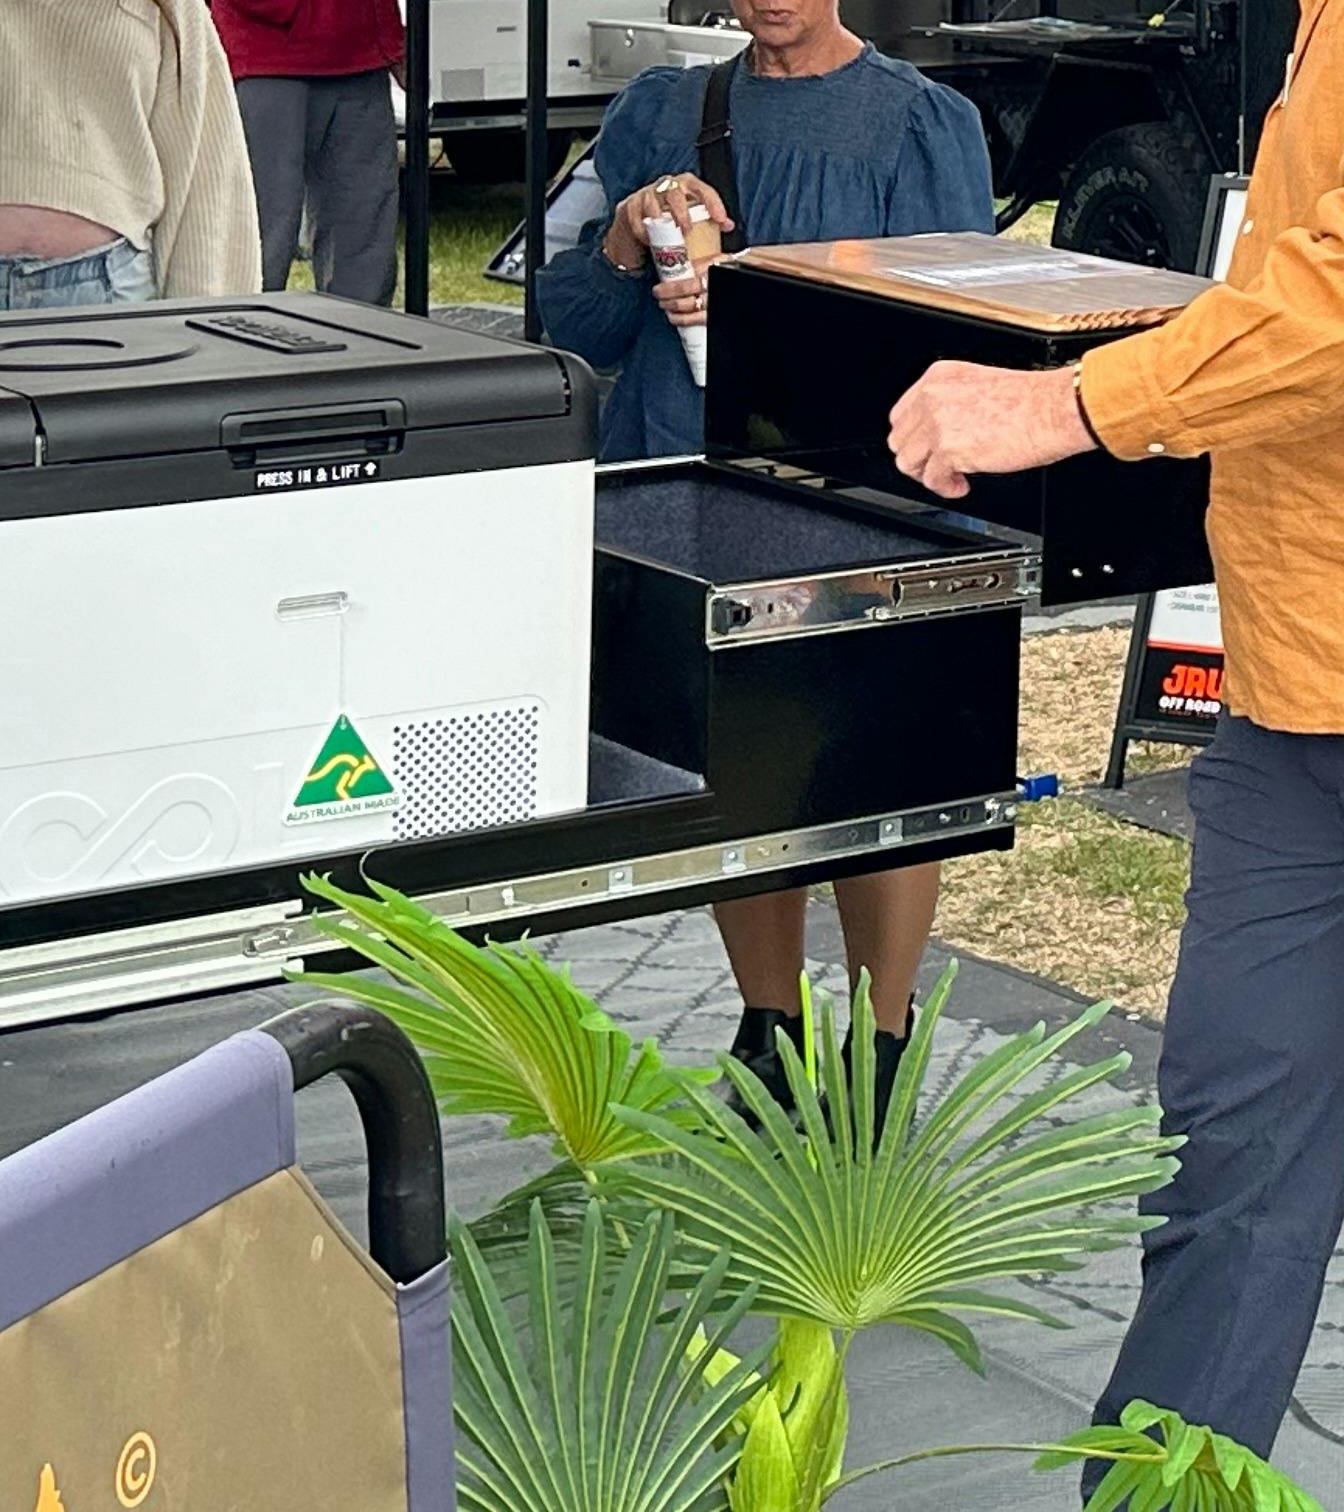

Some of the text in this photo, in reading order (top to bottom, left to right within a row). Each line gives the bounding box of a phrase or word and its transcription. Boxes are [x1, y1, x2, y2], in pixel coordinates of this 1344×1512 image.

[257, 463, 361, 488] PRESS IN & LIFT
[1159, 695, 1184, 710] OFF
[286, 795, 401, 822] AUSTRALIAN MADE
